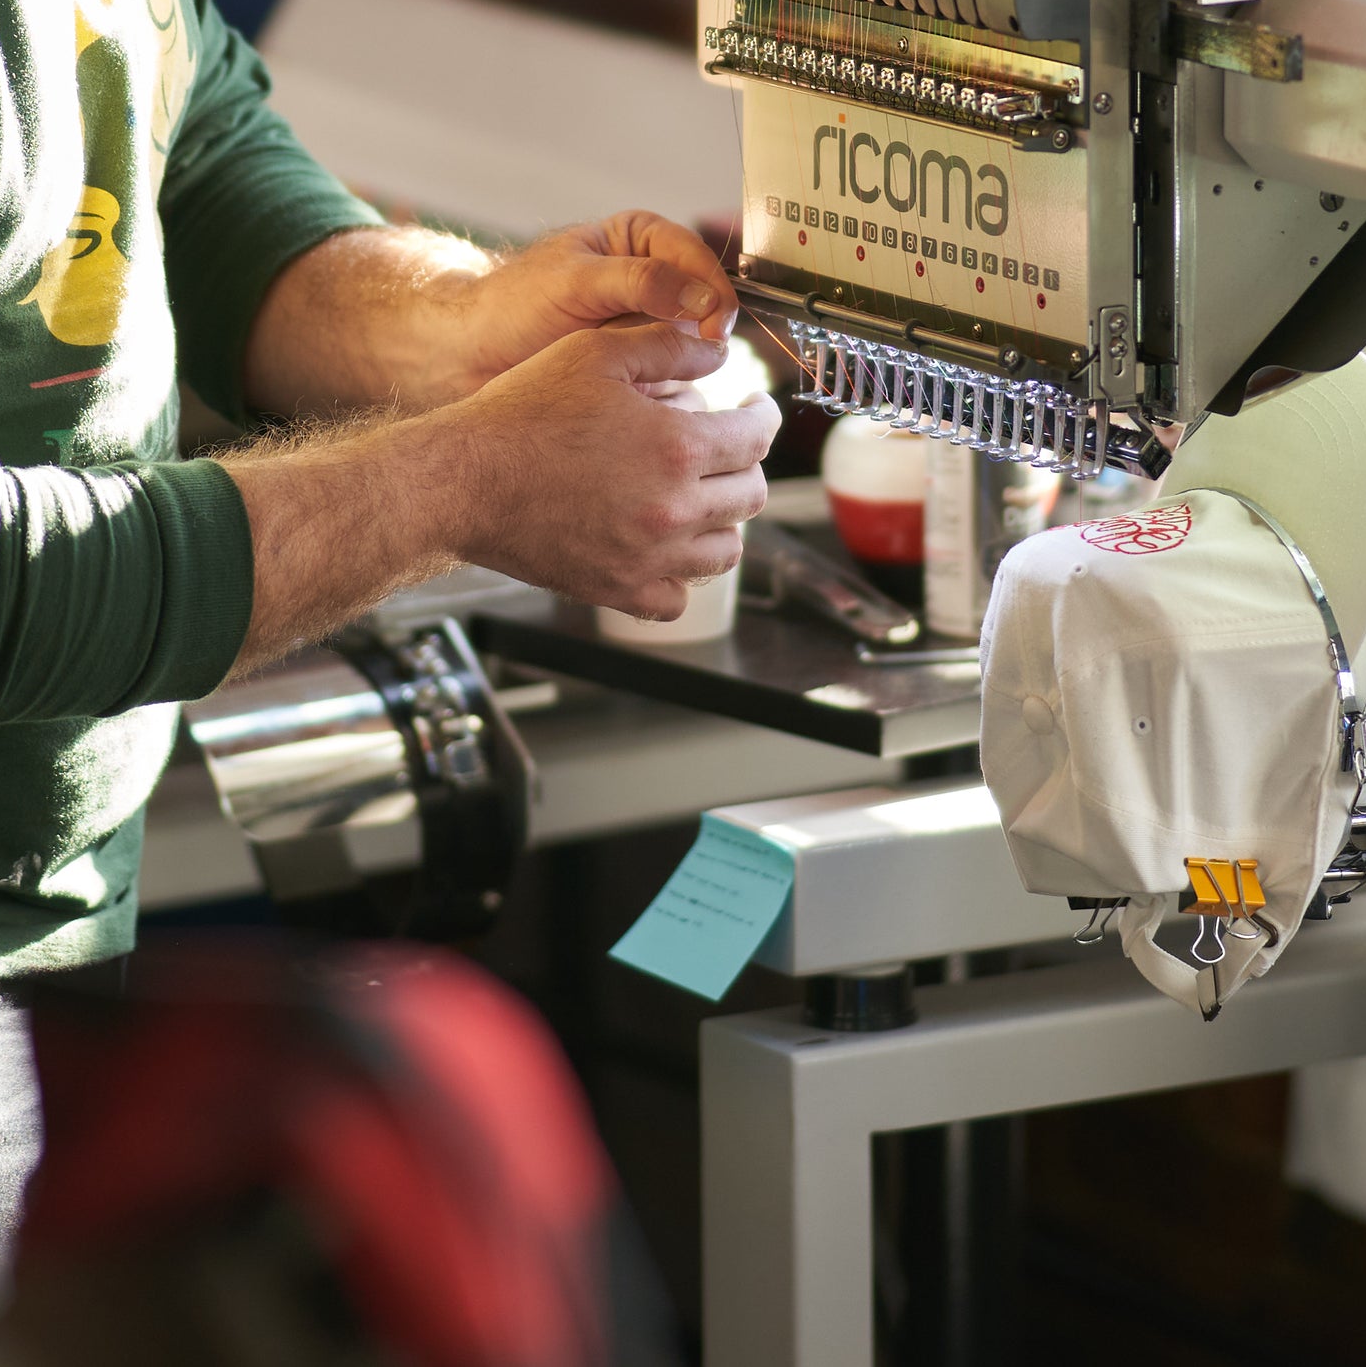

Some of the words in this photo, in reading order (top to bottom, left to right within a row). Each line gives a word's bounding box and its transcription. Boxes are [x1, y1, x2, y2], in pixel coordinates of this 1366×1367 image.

[813, 113, 1009, 236] ricoma
[768, 198, 779, 216] 15
[788, 202, 798, 221] 14
[806, 207, 817, 225] 13
[825, 213, 837, 231] 12
[846, 218, 855, 235] 11
[865, 223, 876, 241] 10
